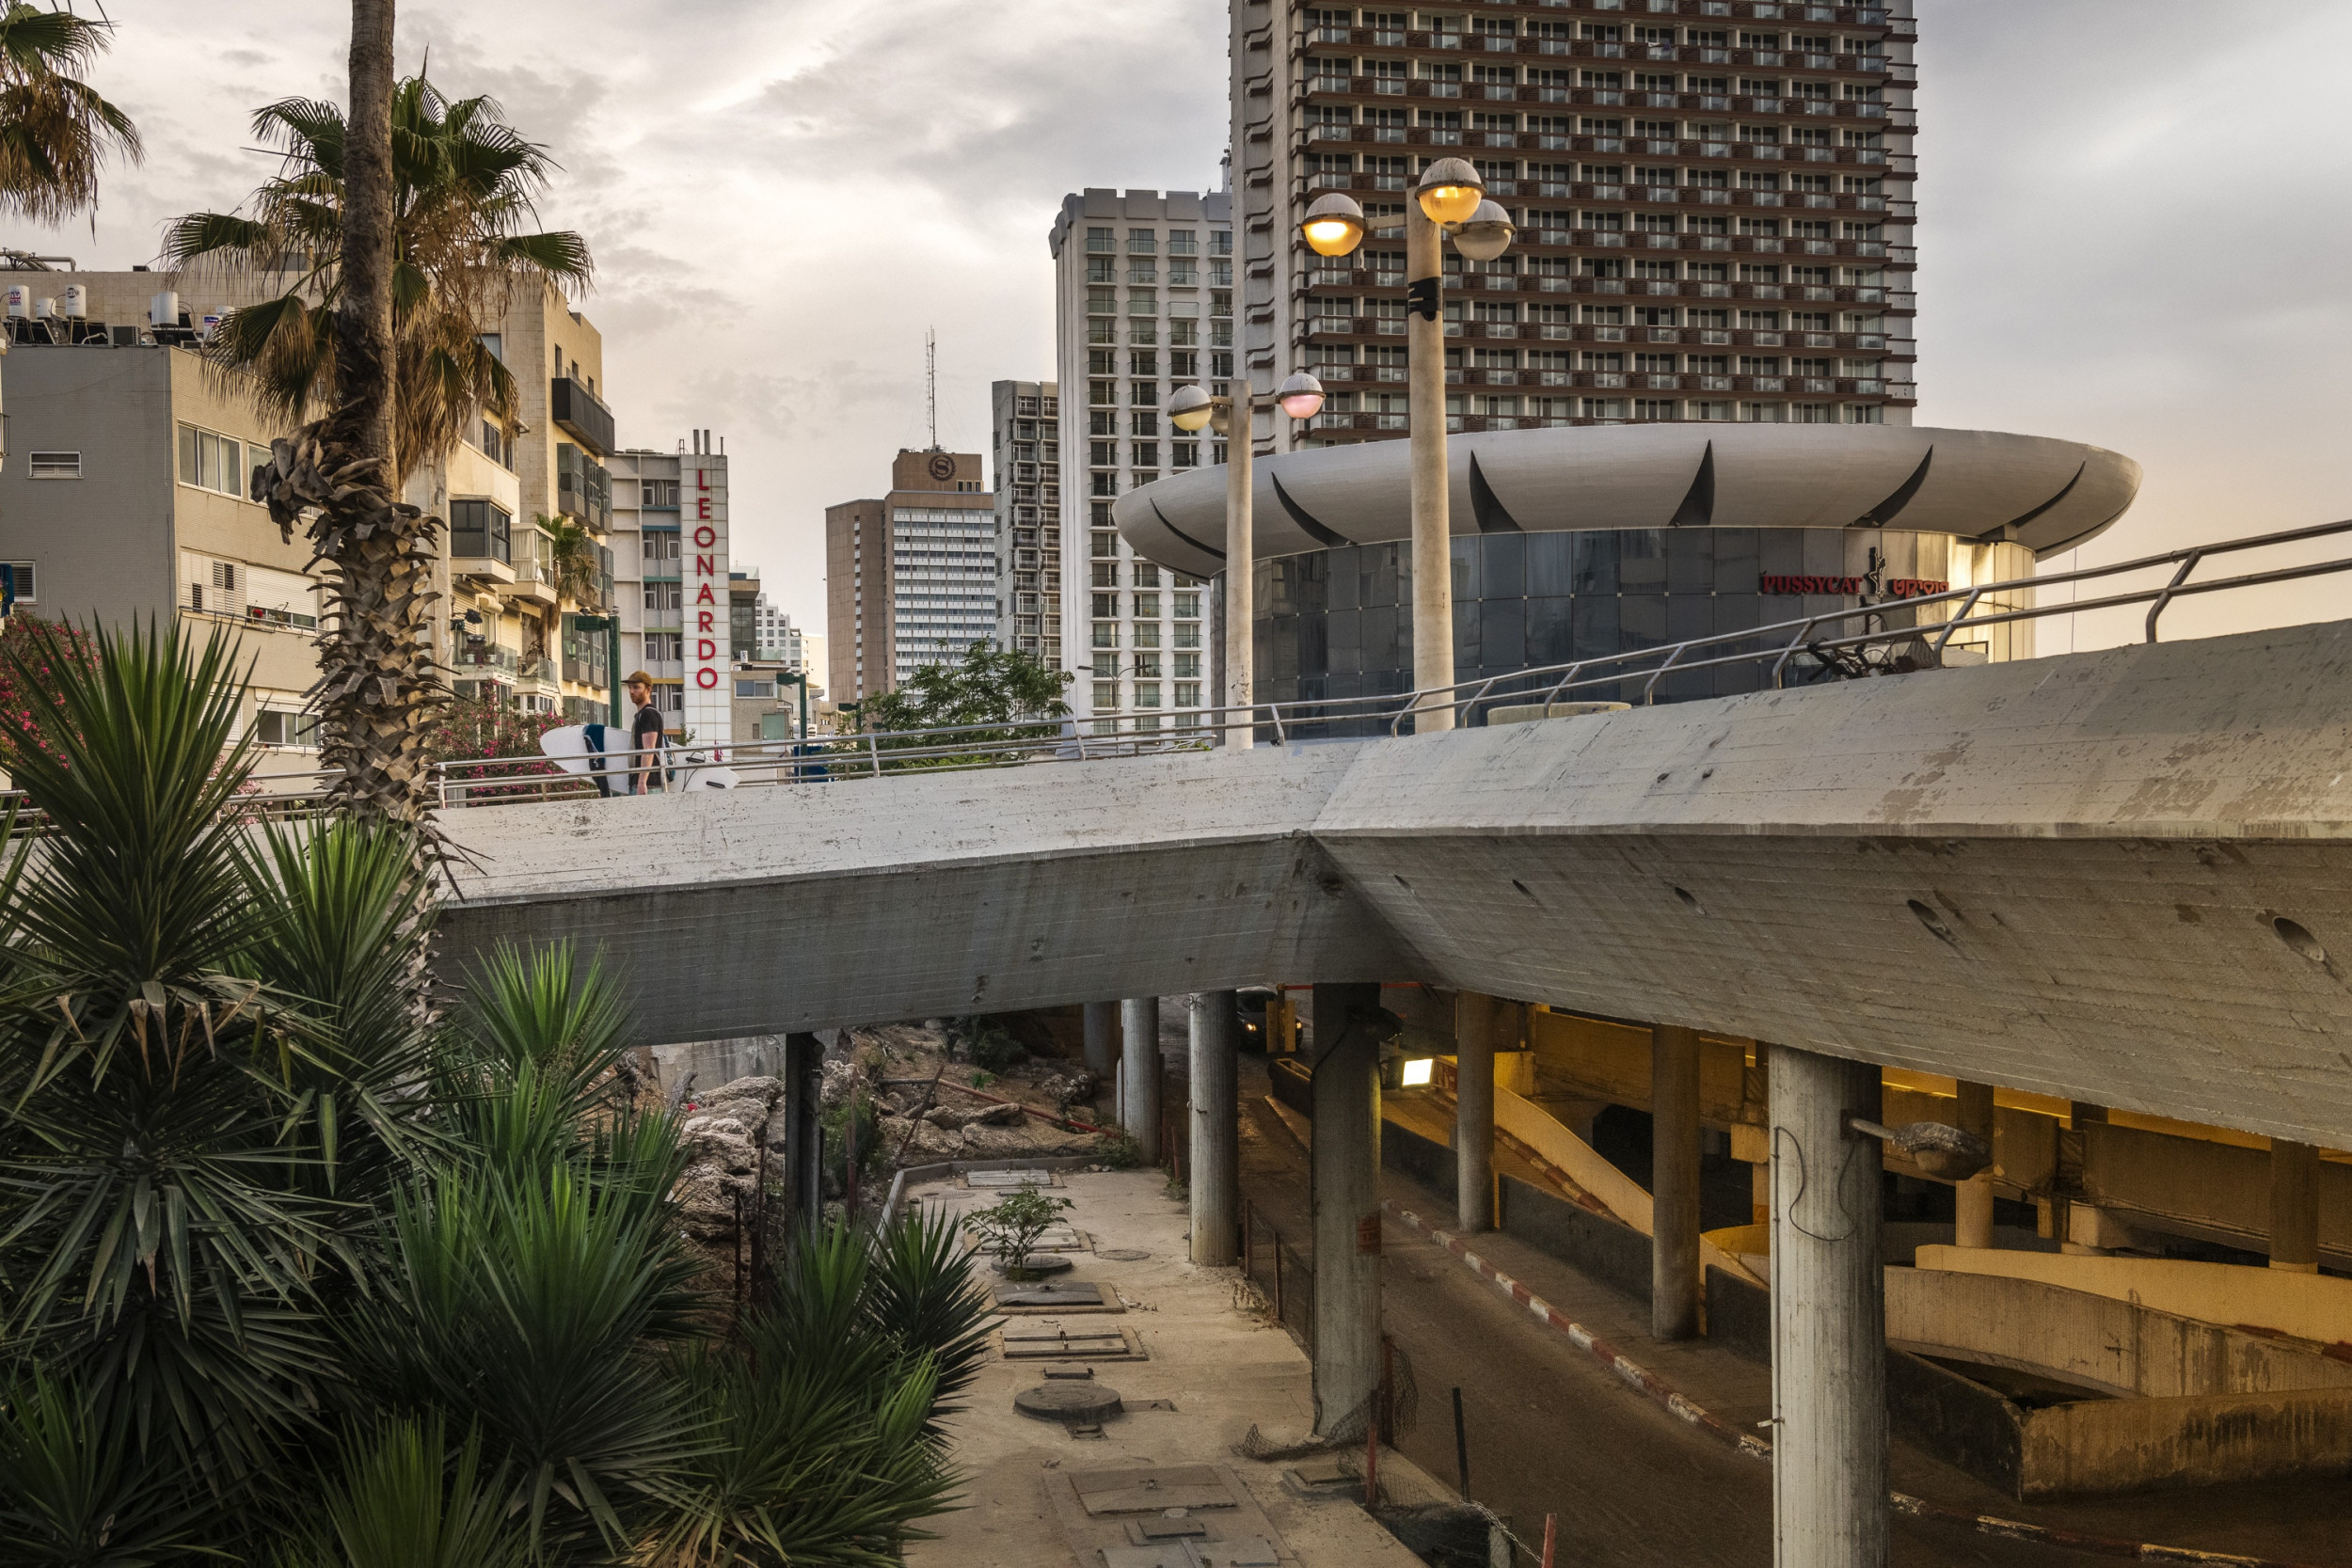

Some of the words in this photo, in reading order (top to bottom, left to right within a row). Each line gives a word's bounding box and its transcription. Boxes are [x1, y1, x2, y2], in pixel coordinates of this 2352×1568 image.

[934, 459, 949, 476] S
[693, 467, 719, 690] LEONARDO
[1762, 575, 1864, 594] PUSSYCAT
